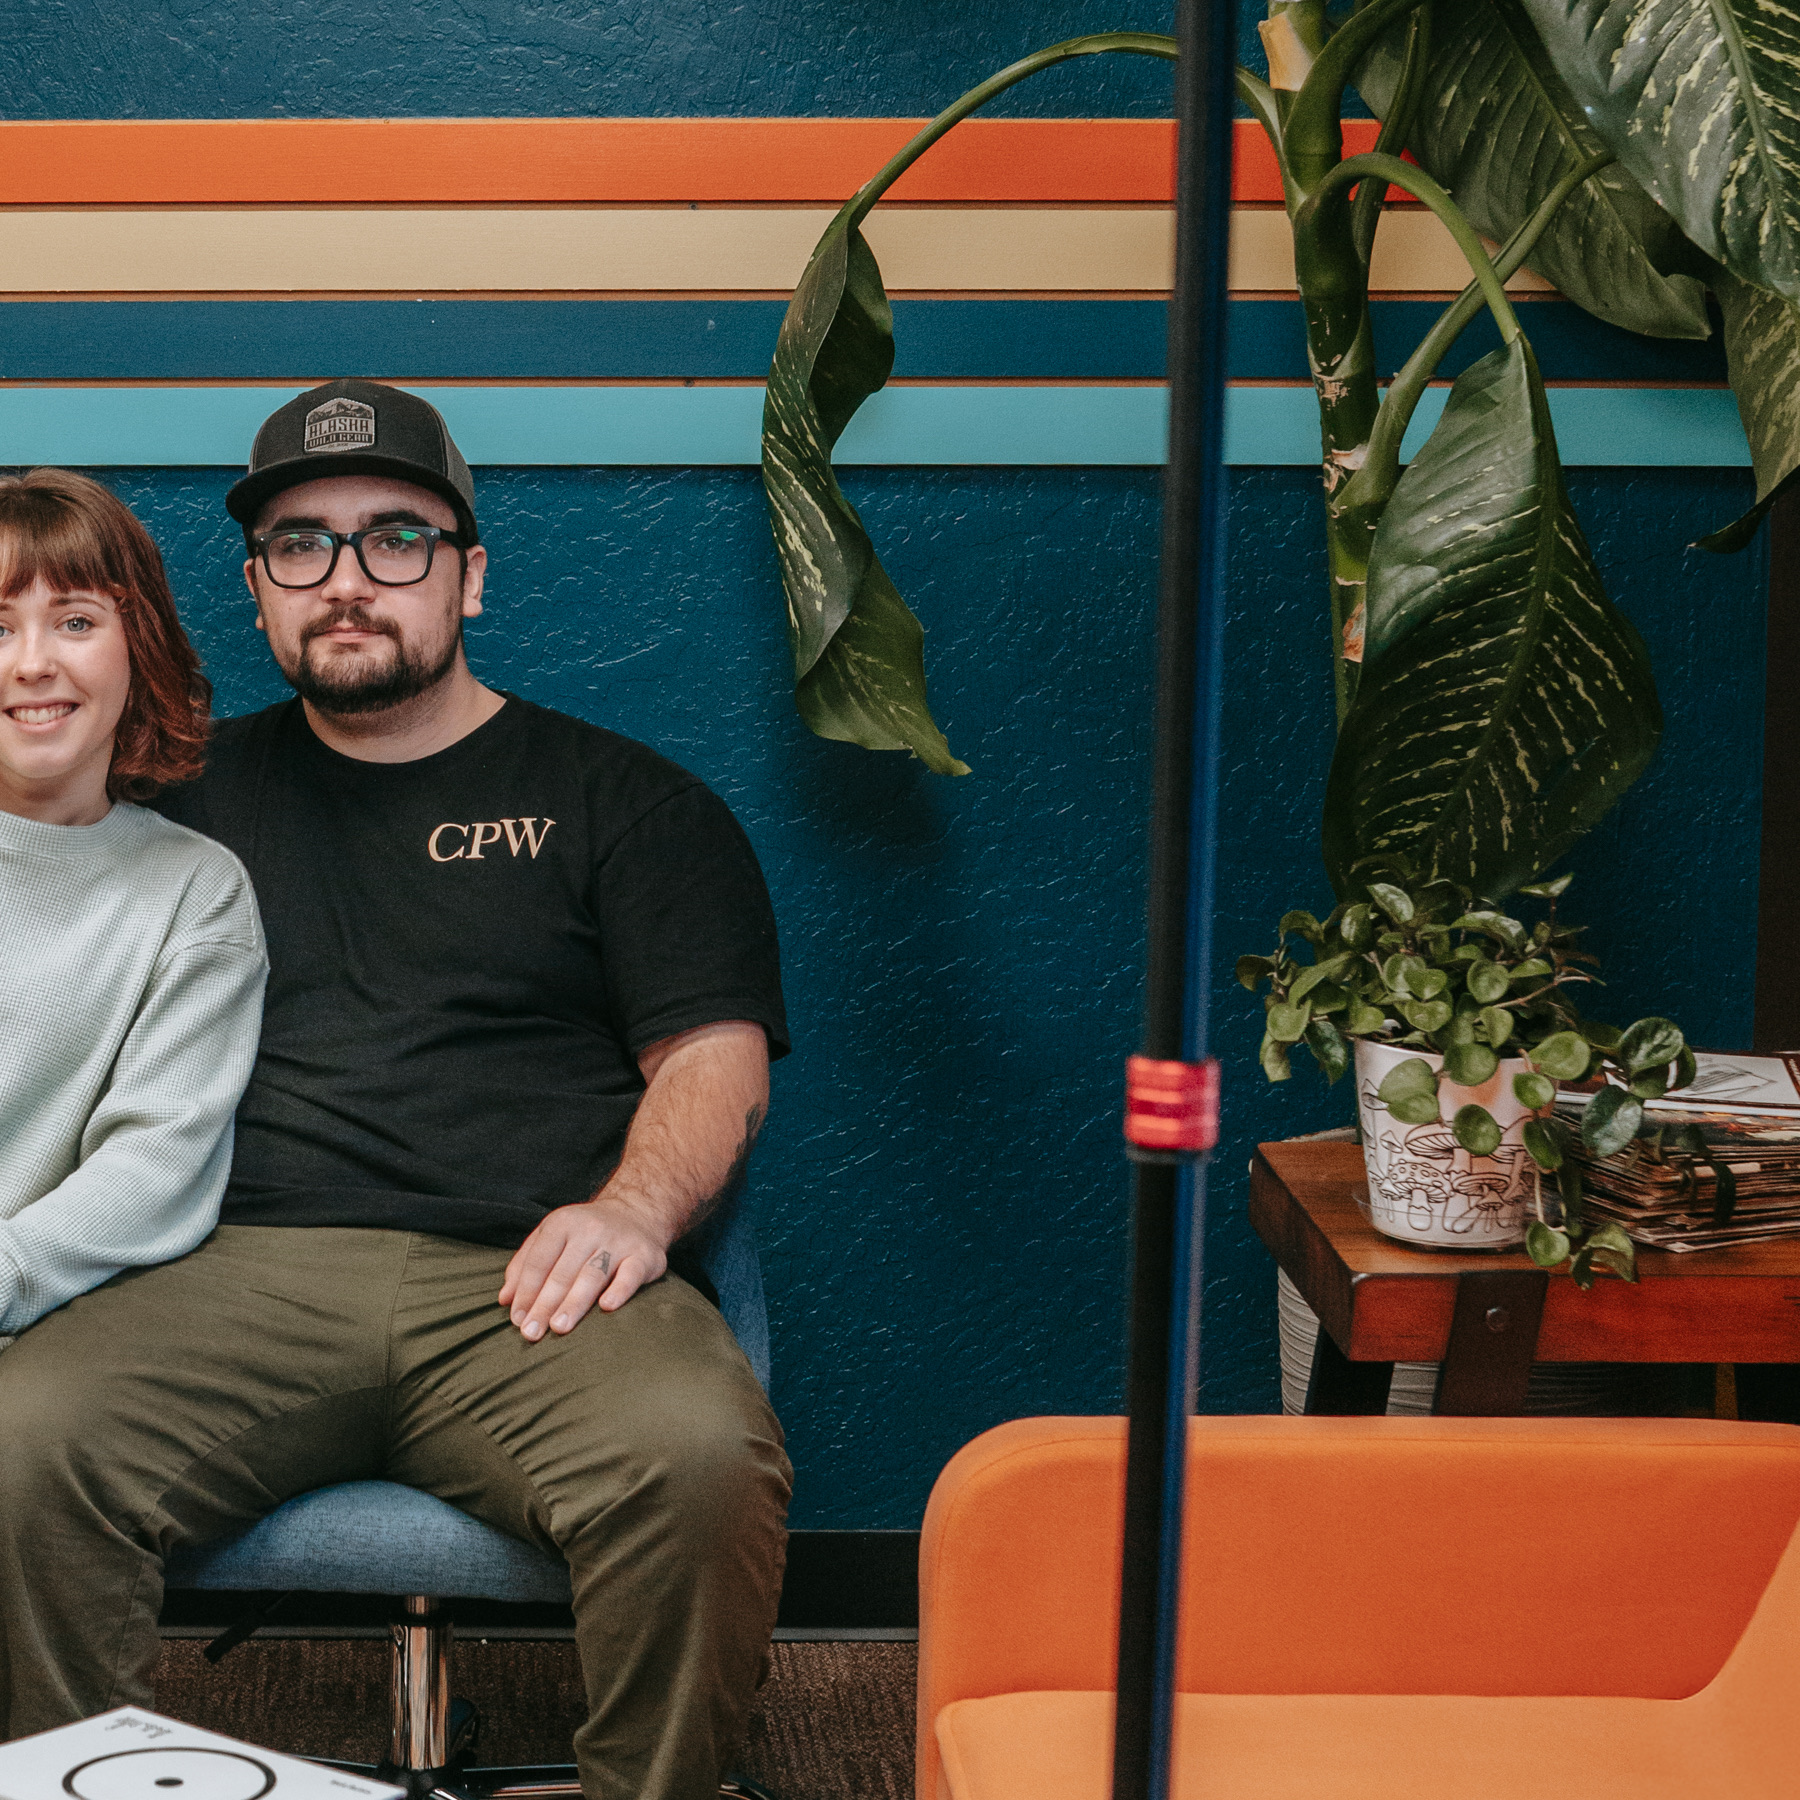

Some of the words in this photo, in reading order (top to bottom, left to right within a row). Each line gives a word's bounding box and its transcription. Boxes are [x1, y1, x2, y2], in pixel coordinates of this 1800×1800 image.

[309, 418, 369, 439] ALASKA
[309, 434, 336, 448] WILD
[339, 433, 369, 442] GEAR
[428, 817, 557, 862] CPW
